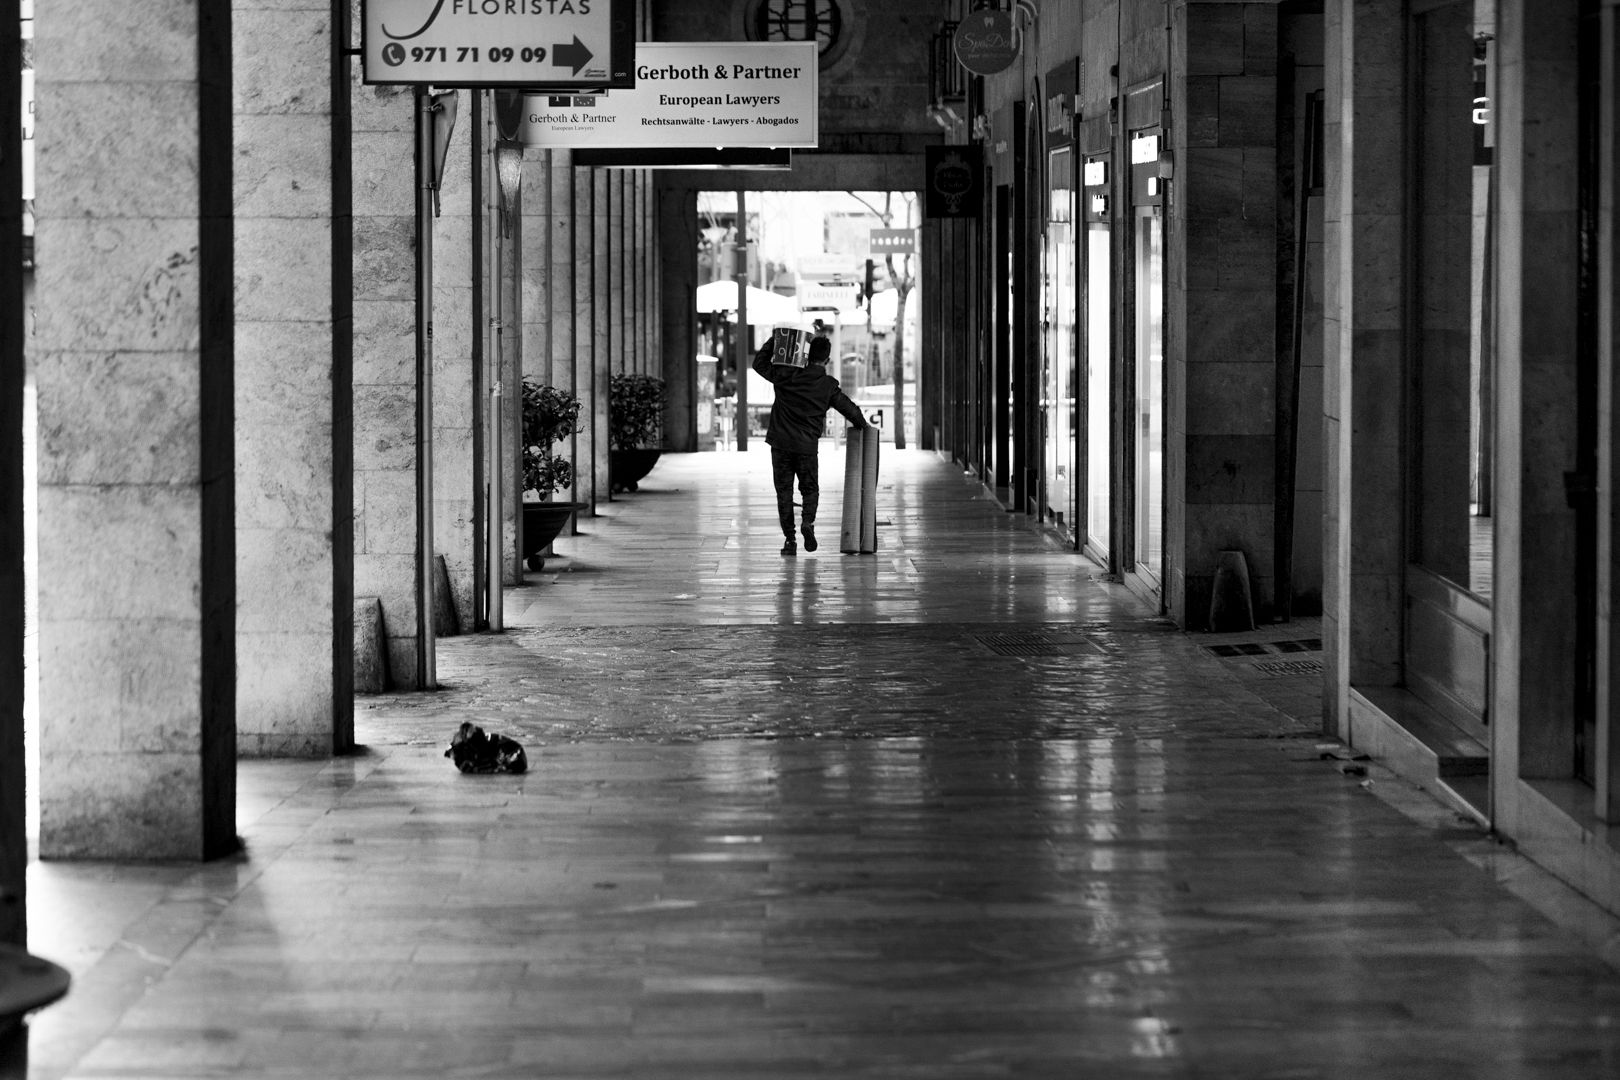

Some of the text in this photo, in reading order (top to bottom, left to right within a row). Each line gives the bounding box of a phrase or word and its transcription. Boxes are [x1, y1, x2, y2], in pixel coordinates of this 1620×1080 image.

[453, 0, 591, 15] FLORISTAS
[410, 46, 547, 63] 971 71 09 09
[637, 64, 802, 80] Gerboth & Partner
[659, 93, 781, 108] European Lawyers
[529, 113, 617, 123] Gerboth & Partner
[641, 117, 706, 126] Rechtsanwälte
[712, 116, 750, 127] Lawyers
[755, 115, 800, 127] Abogados
